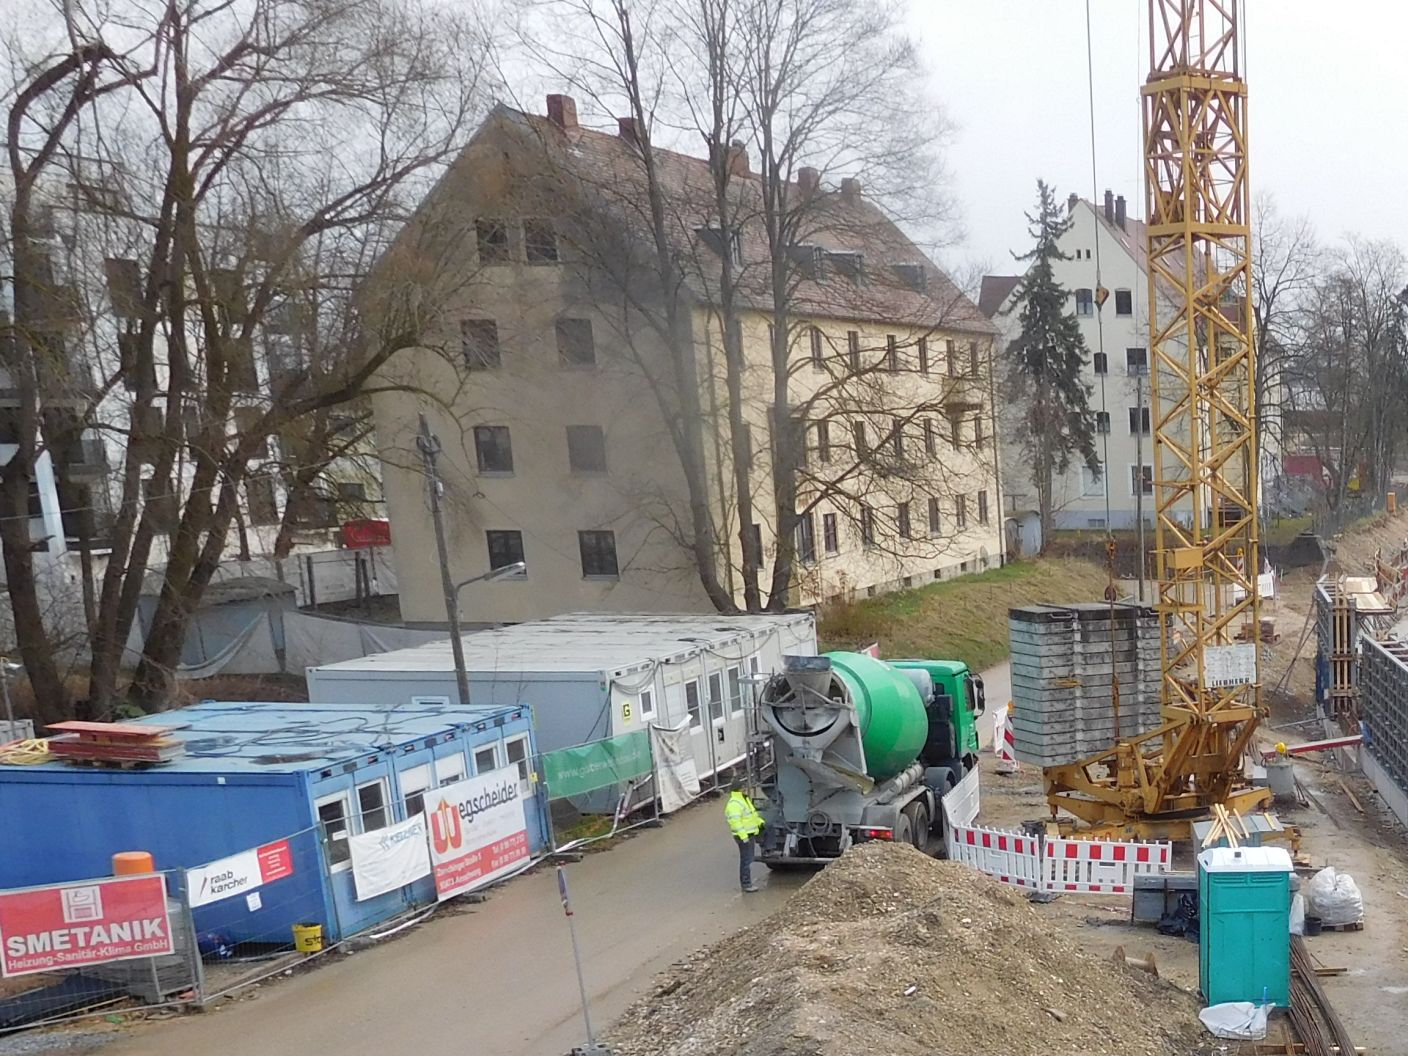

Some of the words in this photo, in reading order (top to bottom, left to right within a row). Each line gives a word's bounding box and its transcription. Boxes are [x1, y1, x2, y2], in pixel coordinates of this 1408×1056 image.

[1211, 677, 1250, 687] LIEBHERR
[623, 703, 631, 717] G
[431, 780, 519, 854] Wegscheider
[210, 870, 234, 885] raab
[210, 876, 248, 894] karcher
[6, 917, 166, 958] SMETANIK
[8, 945, 132, 971] Heizung-Sanitär-Klima
[134, 939, 169, 952] GmbH
